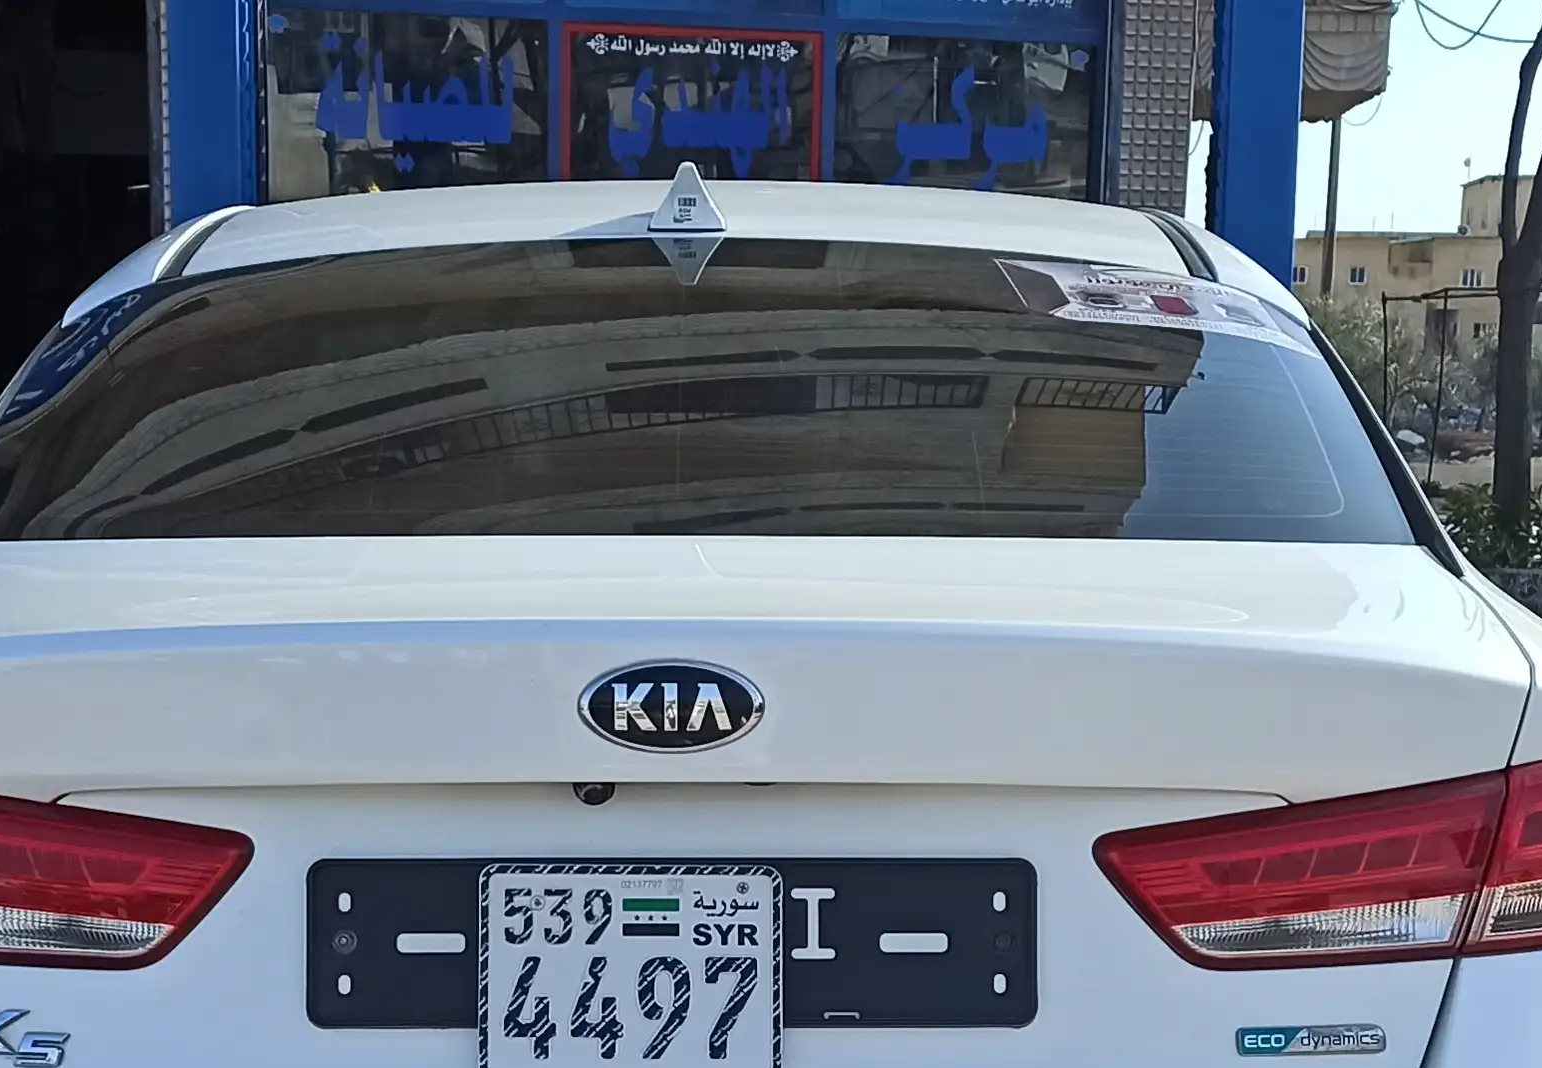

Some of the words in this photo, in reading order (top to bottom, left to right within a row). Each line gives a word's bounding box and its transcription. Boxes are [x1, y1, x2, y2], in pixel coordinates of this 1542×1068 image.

[610, 35, 632, 52] الله
[635, 38, 667, 57] رسول
[669, 40, 700, 55] محمد
[705, 37, 727, 56] الله
[611, 683, 733, 732] KIA
[692, 890, 760, 917] سورية
[503, 887, 613, 945] 539
[692, 923, 760, 947] SYR
[503, 955, 759, 1060] 4497
[1244, 1034, 1286, 1048] ECO
[1300, 1033, 1381, 1050] dynamics
